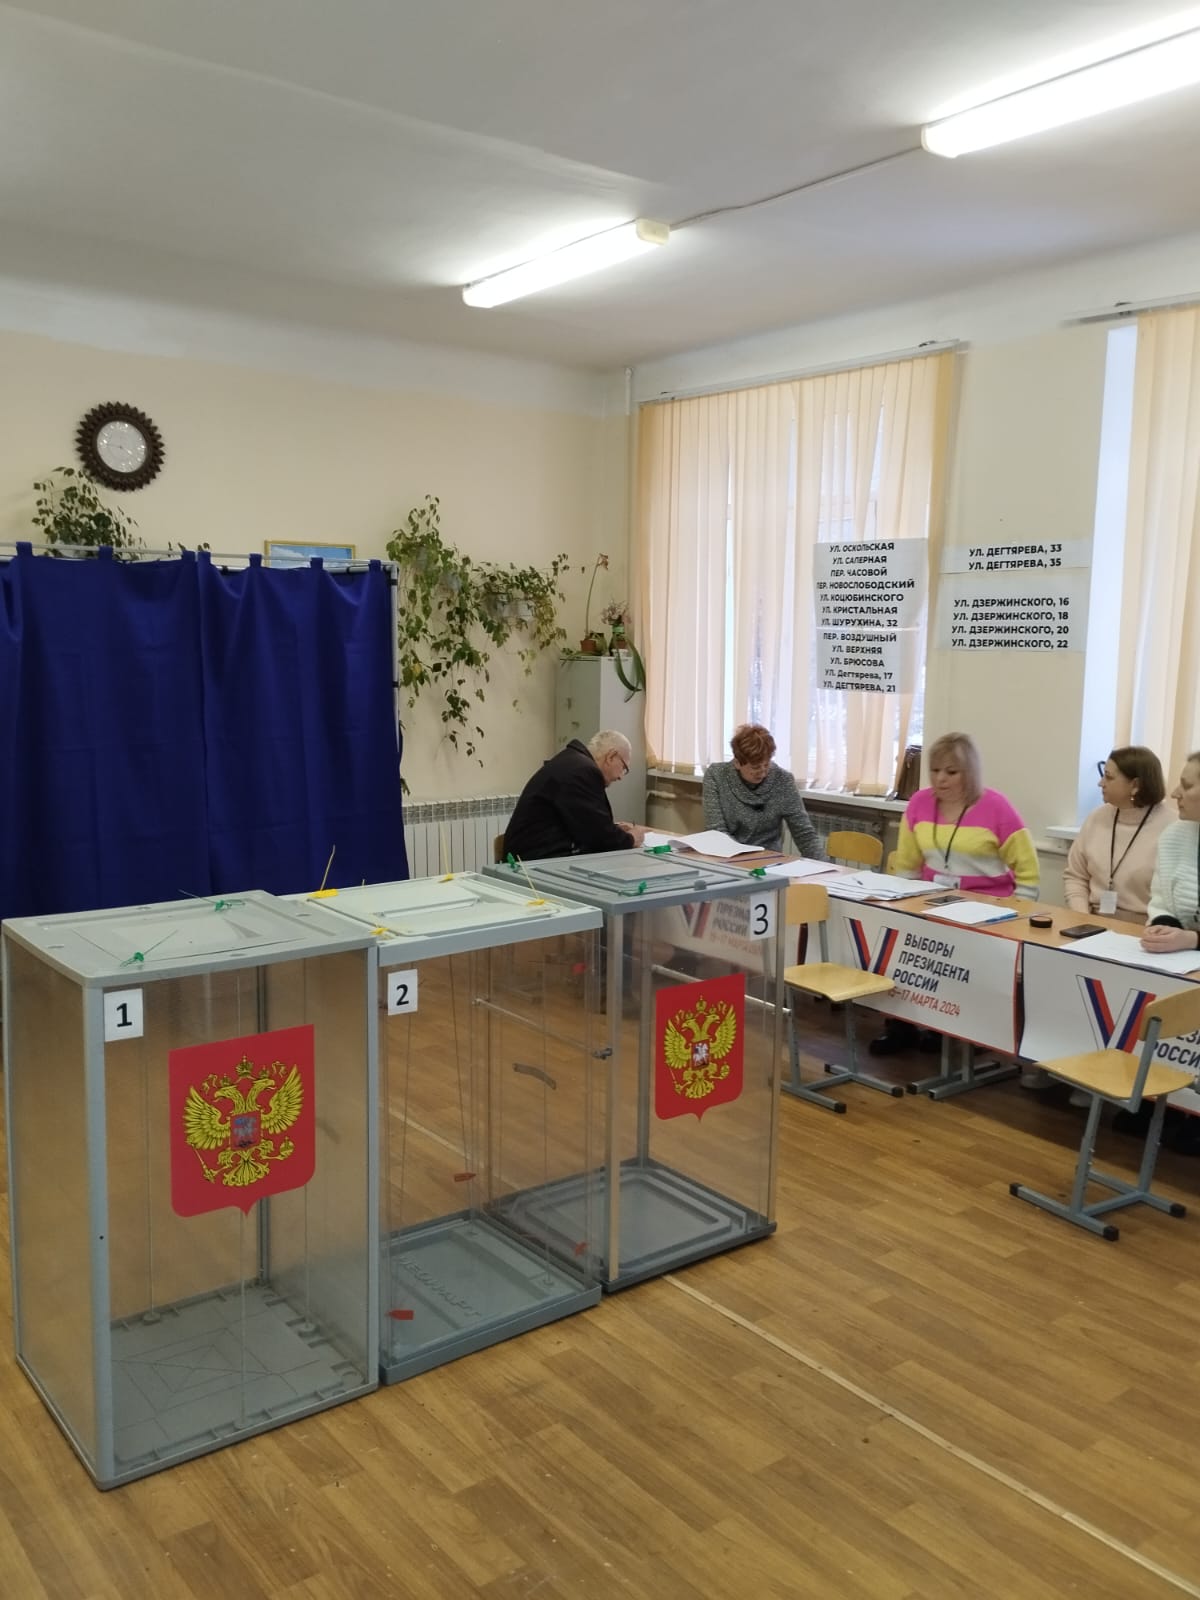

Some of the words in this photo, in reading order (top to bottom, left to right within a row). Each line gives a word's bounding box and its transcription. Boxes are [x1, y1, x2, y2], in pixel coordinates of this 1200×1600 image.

[829, 545, 841, 553] УЛ.
[842, 542, 895, 552] ОСКОЛЬСКАЯ
[968, 549, 984, 557] УЛ.
[986, 545, 1048, 557] ДЕГТЯРЕВА,
[1050, 544, 1062, 552] 33
[832, 557, 844, 565] УЛ.
[845, 555, 887, 564] САПЕРНАЯ
[968, 562, 984, 571] УЛ.
[986, 559, 1047, 571] ДЕГТЯРЕВА,
[1050, 558, 1062, 567] 35
[846, 567, 888, 577] ЧАСОВОЙ
[829, 578, 915, 590] НОВОСЛОБОДСКИЙ
[831, 593, 904, 602] КОЦЮБИНСКОГО
[954, 599, 970, 608] УЛ.
[971, 598, 1056, 609] ДЗЕРЖИНСКОГО,
[1059, 597, 1070, 606] 16
[833, 606, 898, 614] КРИСТАЛЬНАЯ
[953, 612, 969, 621] УЛ.
[970, 612, 1056, 622] ДЗЕРЖИНСКОГО,
[1058, 611, 1069, 620] 18
[832, 619, 885, 627] ШУРУХИНА,
[886, 619, 898, 627] 32
[951, 625, 967, 634] УЛ.
[968, 625, 1055, 635] ДЗЕРЖИНСКОГО,
[1056, 625, 1069, 634] 20
[823, 633, 839, 641] ПЕР.
[840, 633, 897, 642] ВОЗДУШНЫЙ
[832, 645, 844, 653] УЛ.
[846, 646, 882, 654] ВЕРХНЯЯ
[951, 639, 967, 647] УЛ.
[968, 639, 1054, 649] ДЗЕРЖИНСКОГО,
[1056, 640, 1068, 648] 22
[830, 657, 842, 665] УЛ.
[843, 658, 885, 667] БРЮСОВА
[837, 670, 882, 680] Дегтярева,
[884, 672, 893, 680] 17
[823, 681, 834, 689] УЛ.
[835, 682, 885, 692] ДЕГТЯРЕВА,
[753, 903, 769, 935] 3
[904, 932, 955, 958] ВЫБОРЫ
[898, 950, 970, 983] ПРЕЗИДЕНТА
[892, 968, 939, 992] РОССИИ
[395, 983, 410, 1006] 2
[911, 992, 938, 1011] МАРТА
[939, 1000, 961, 1016] 2024
[116, 1002, 132, 1028] 1
